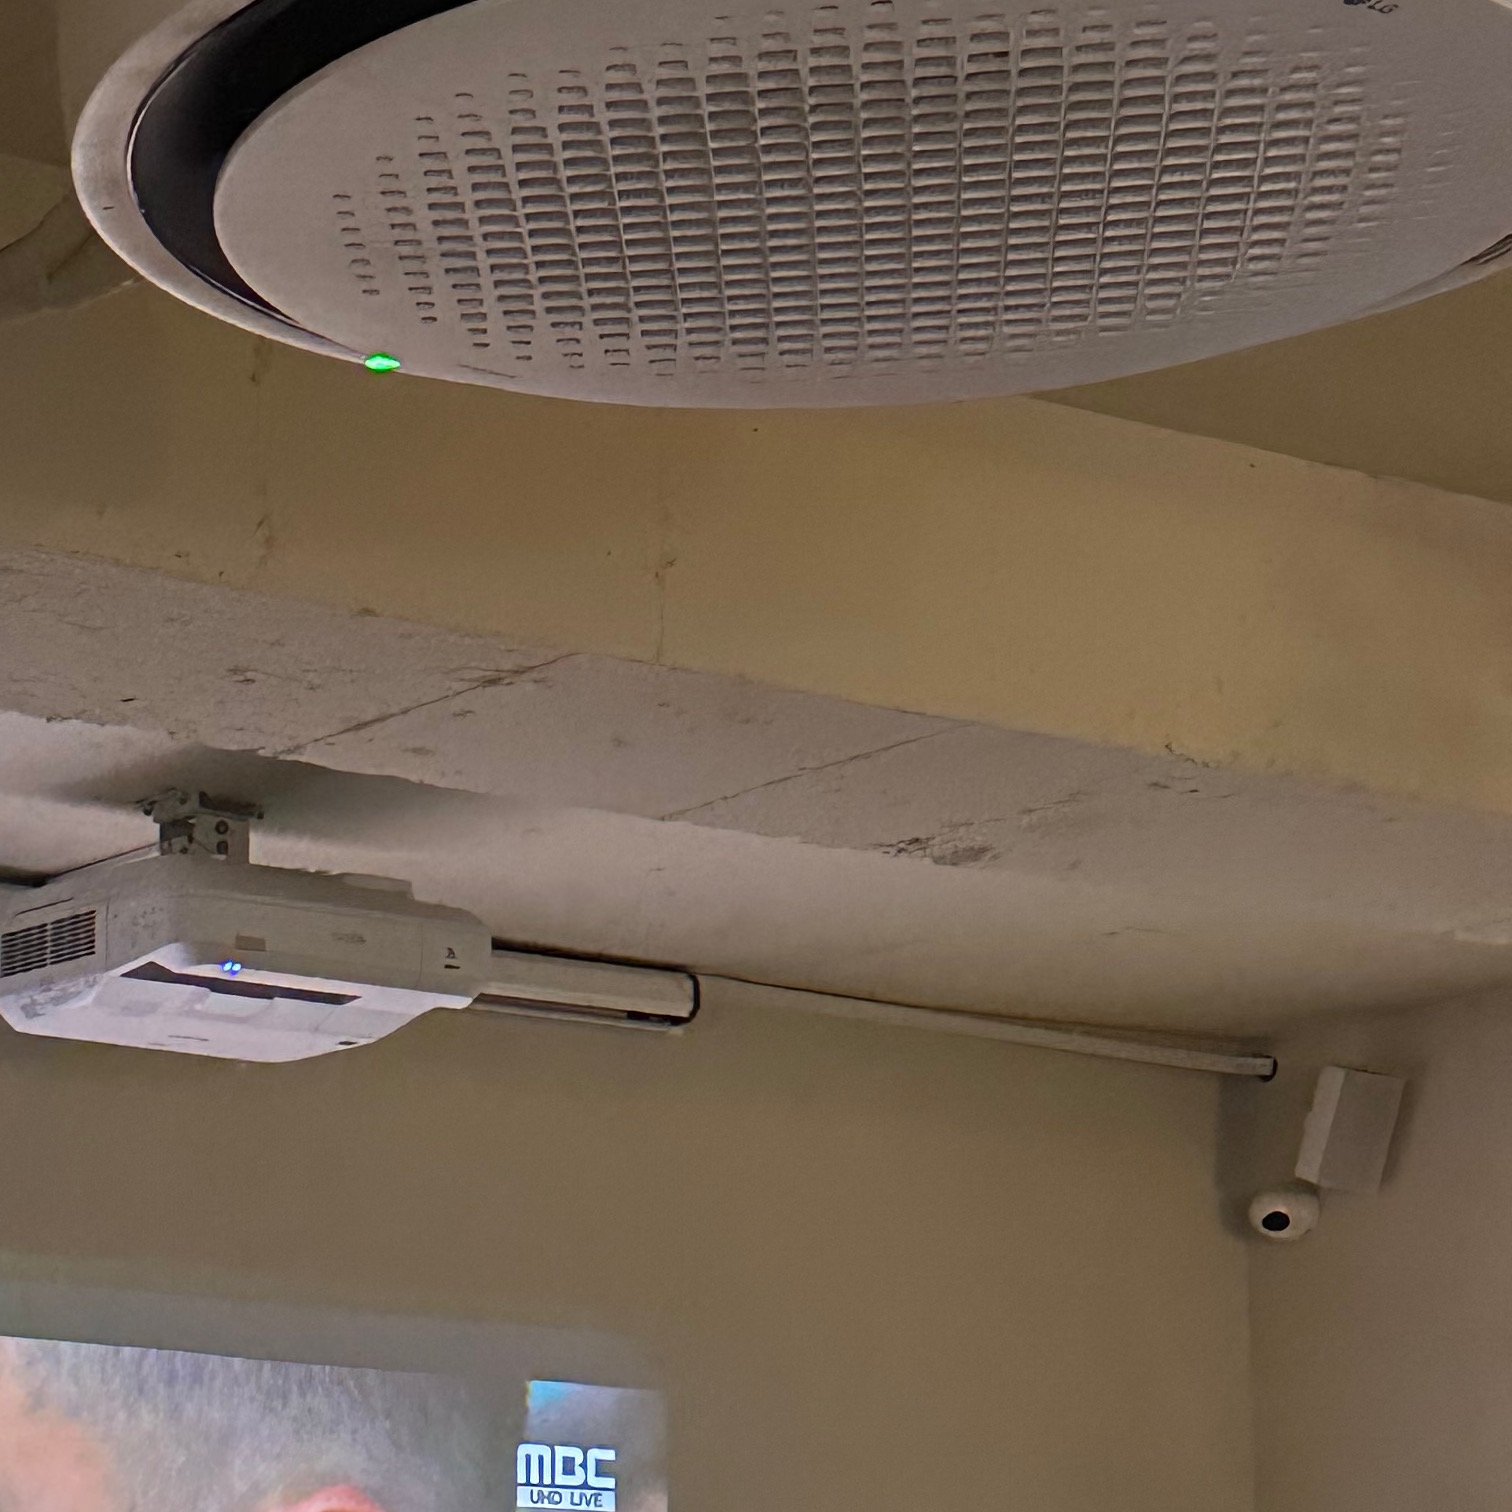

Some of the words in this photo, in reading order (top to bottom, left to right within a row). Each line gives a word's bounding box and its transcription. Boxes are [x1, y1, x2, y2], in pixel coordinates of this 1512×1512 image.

[516, 1443, 616, 1490] MBC
[530, 1489, 563, 1506] UHD
[570, 1491, 603, 1508] LIVE
